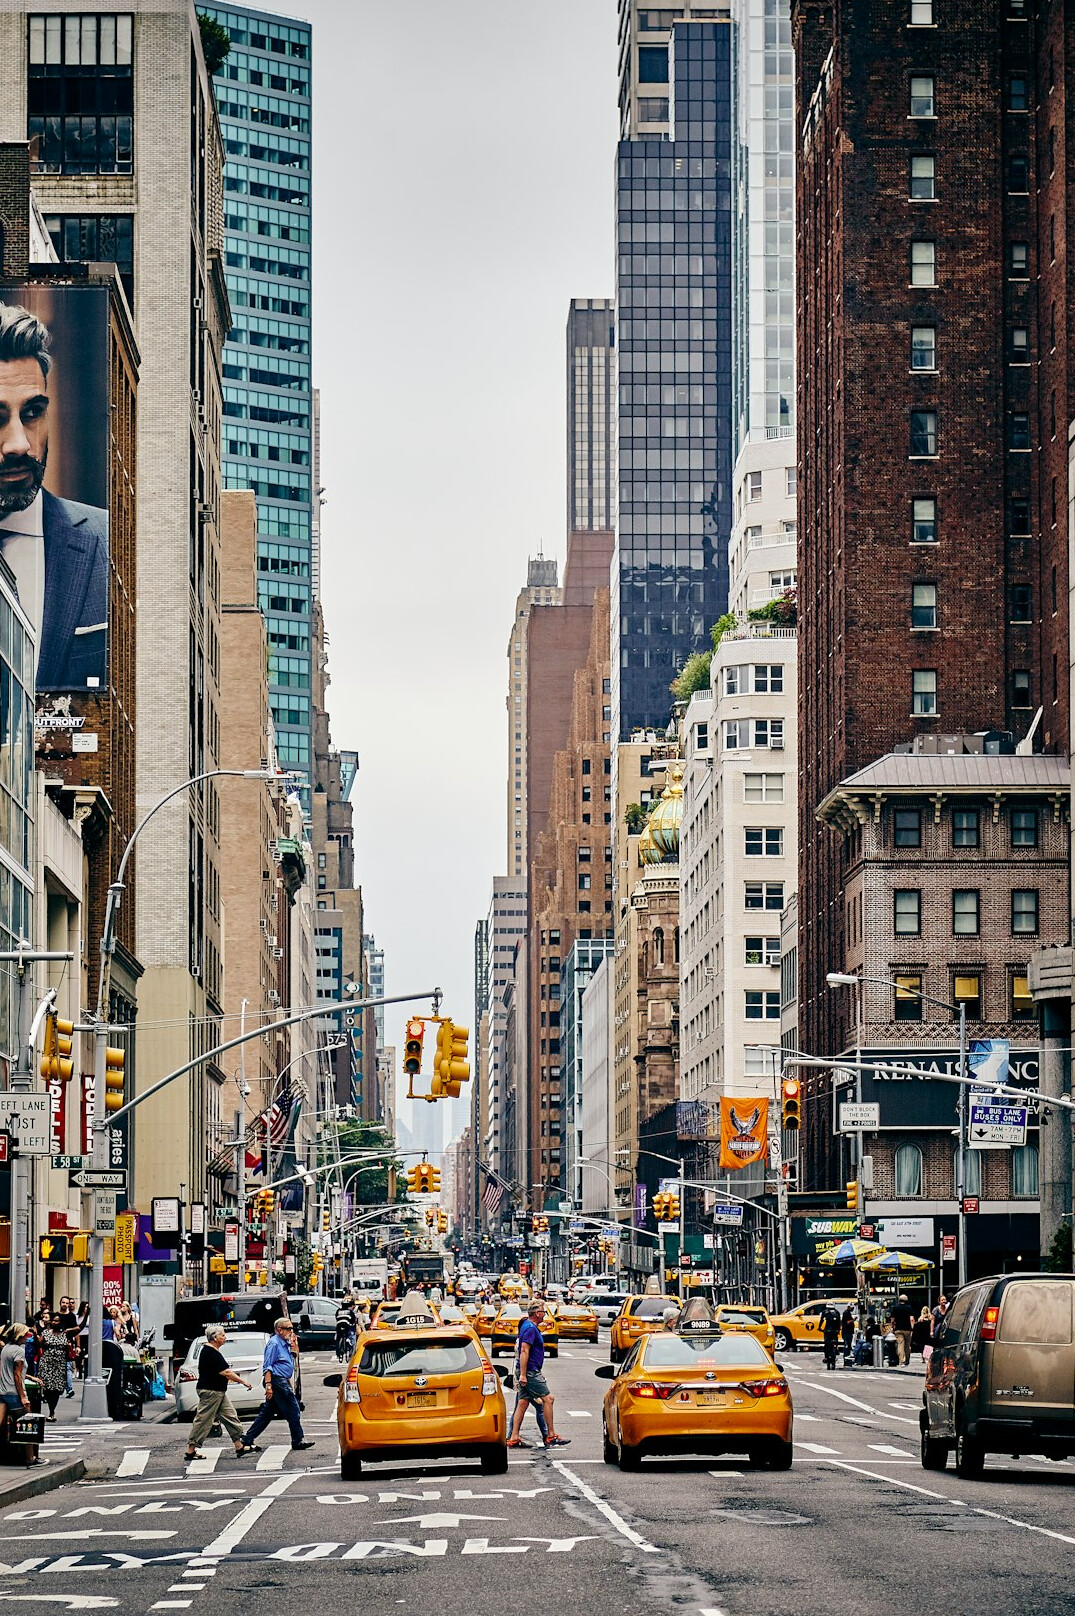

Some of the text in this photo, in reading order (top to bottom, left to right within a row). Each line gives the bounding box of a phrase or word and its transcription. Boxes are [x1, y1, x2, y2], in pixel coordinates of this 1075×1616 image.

[22, 1101, 45, 1110] LANE
[5, 1118, 35, 1129] MST
[23, 1137, 45, 1146] LEFT
[52, 1157, 58, 1168] E
[60, 1156, 70, 1168] 58
[77, 1174, 119, 1183] ONE WAY
[807, 1221, 857, 1234] SUBWAY
[124, 1219, 132, 1259] PASSPORT
[405, 1316, 425, 1324] 1G15
[316, 1488, 555, 1505] ONLY
[3, 1499, 242, 1520] ONLY
[266, 1536, 600, 1561] ONLY
